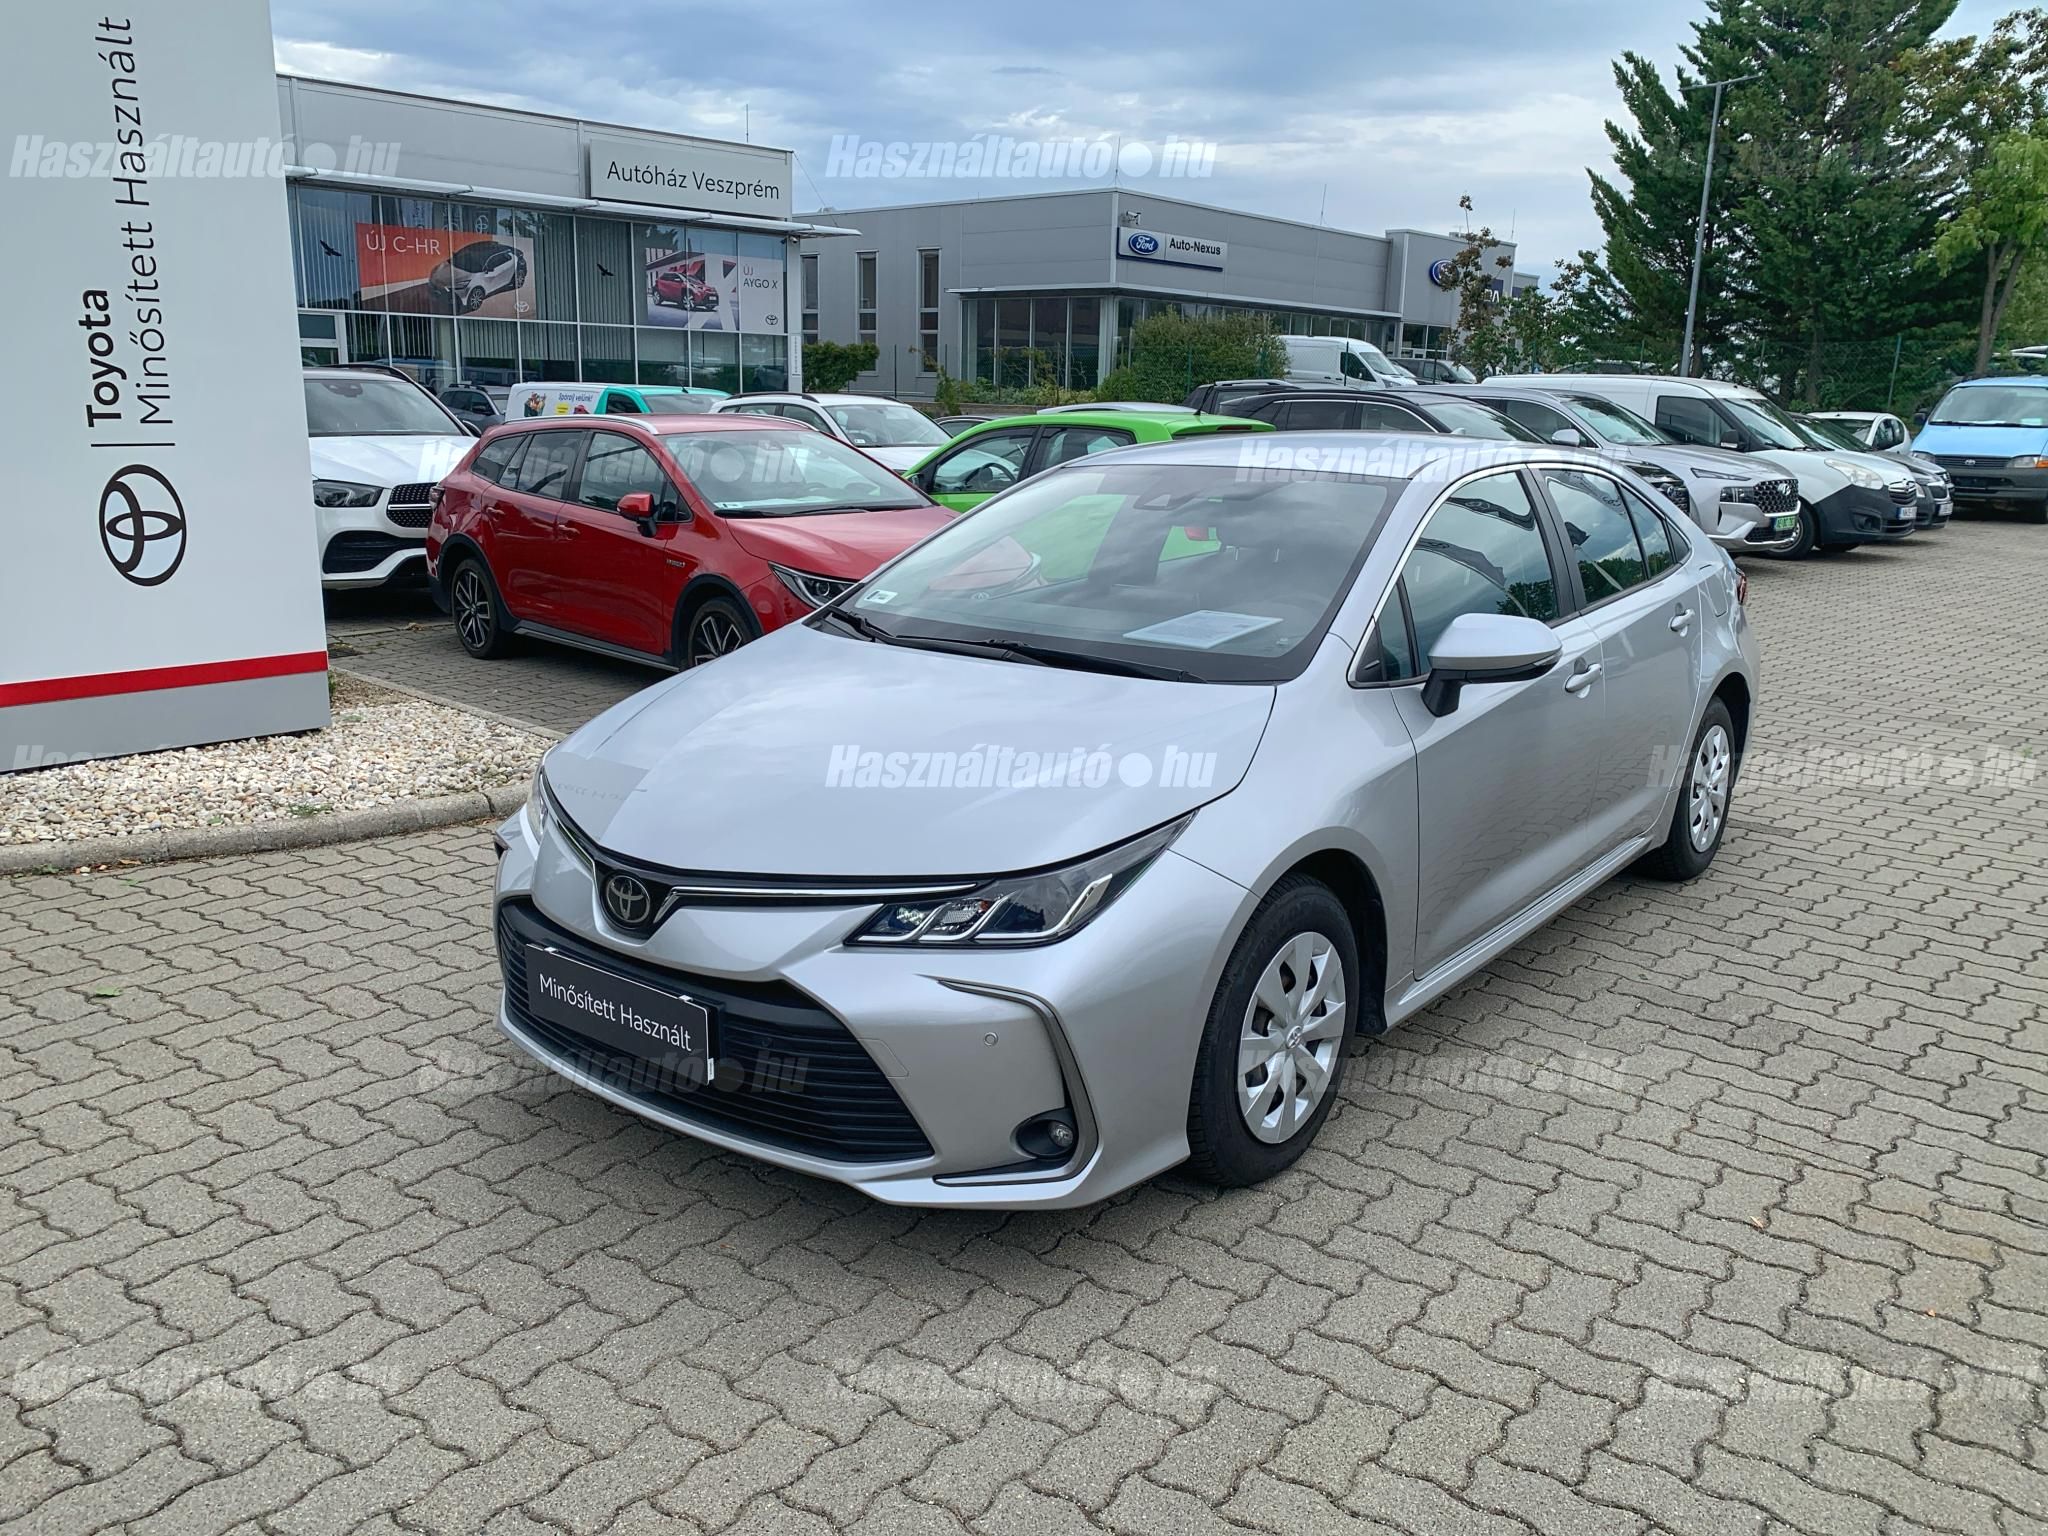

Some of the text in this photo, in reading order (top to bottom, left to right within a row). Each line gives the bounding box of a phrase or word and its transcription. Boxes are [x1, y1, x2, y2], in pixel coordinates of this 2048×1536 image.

[607, 161, 779, 200] Autóház Veszprém
[95, 16, 173, 424] Minősített Használt
[365, 230, 441, 255] ÚJ C-HR
[1169, 238, 1221, 256] Auto-Nexus
[743, 278, 778, 289] AYGO X
[78, 290, 127, 427] Toyota
[539, 973, 692, 1052] Minősített Használt
